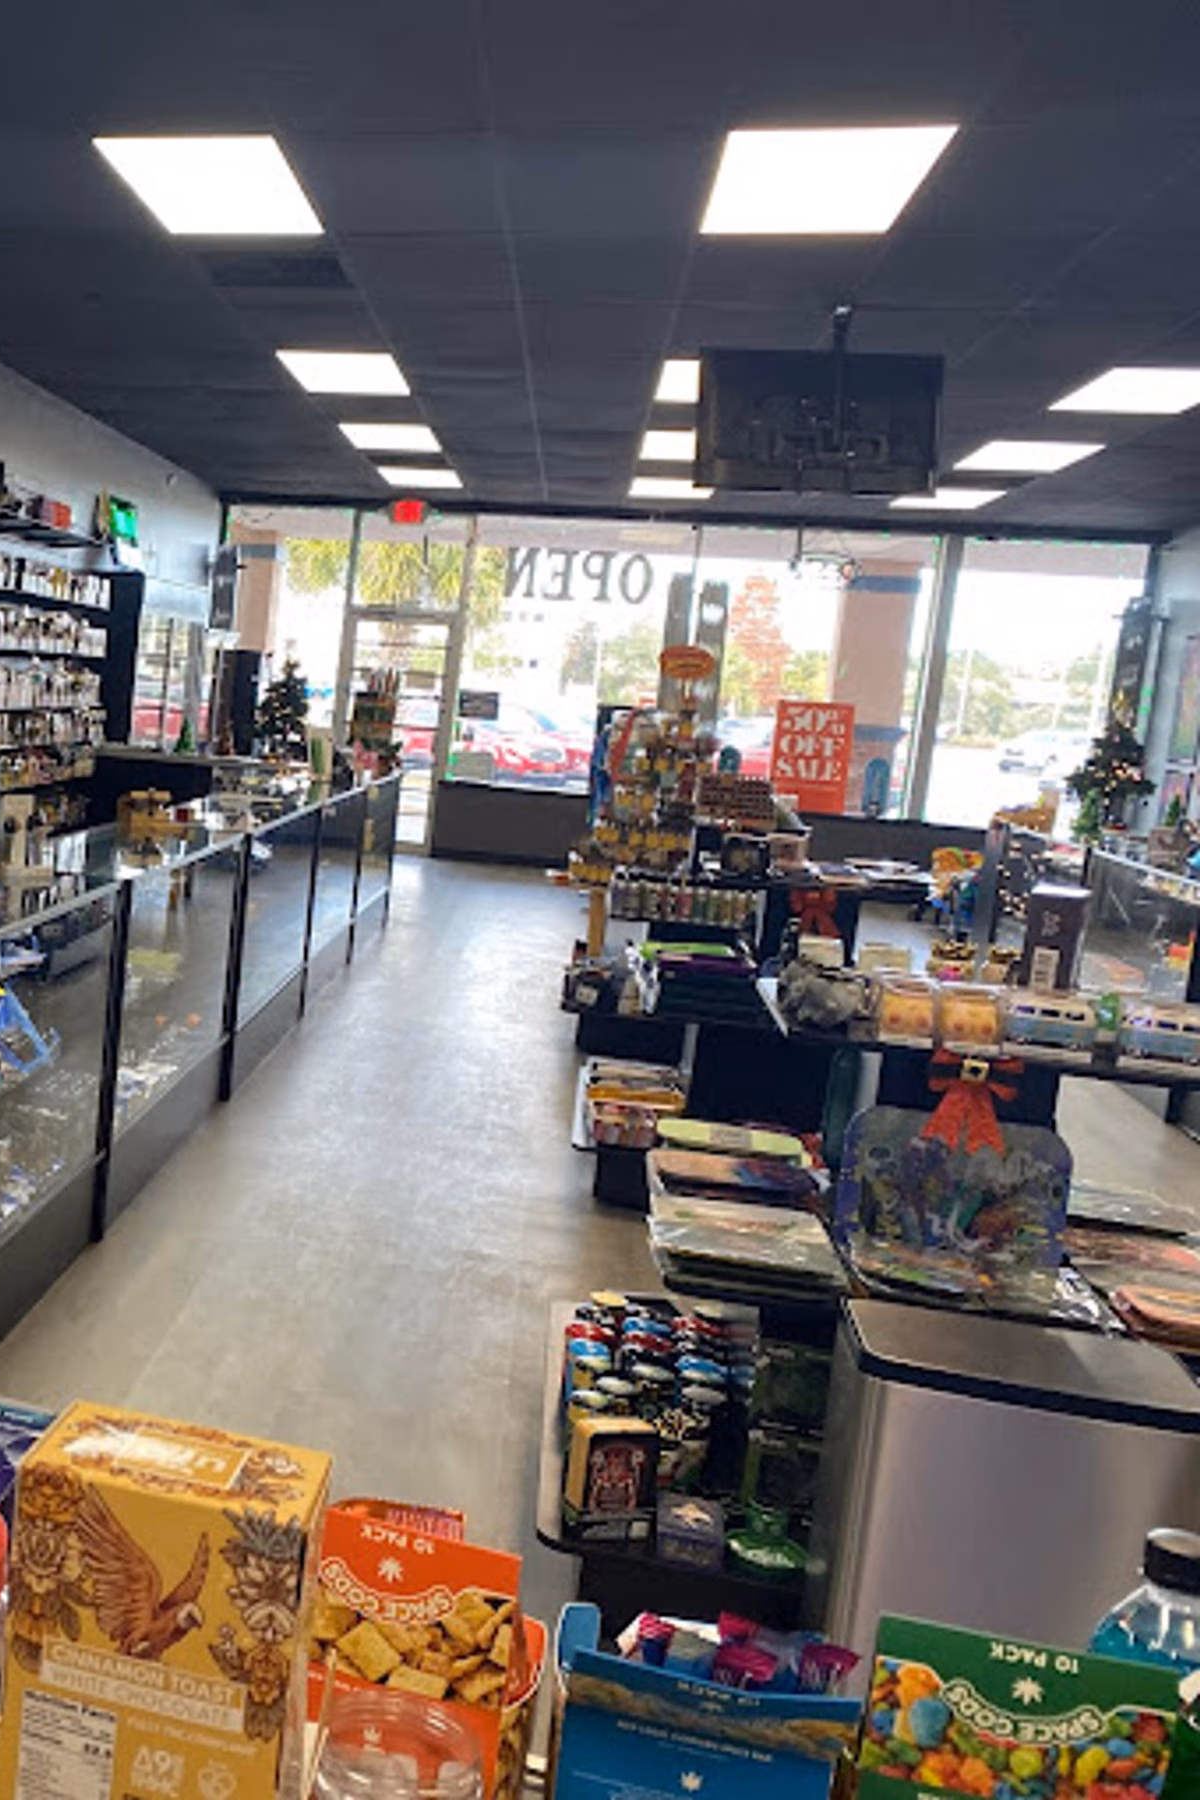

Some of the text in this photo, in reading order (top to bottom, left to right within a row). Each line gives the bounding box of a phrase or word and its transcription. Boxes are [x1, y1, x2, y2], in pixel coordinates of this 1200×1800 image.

[784, 705, 845, 735] 50%
[781, 735, 844, 757] OFF
[777, 757, 841, 781] SALE
[361, 1525, 435, 1555] 10 PACK
[384, 1591, 451, 1621] SPACE
[989, 1641, 1078, 1673] 10 PACK
[51, 1643, 235, 1703] CINNAMON TOAST
[52, 1668, 230, 1723] WHITE CHOCOLATE
[1016, 1709, 1100, 1742] SPACE
